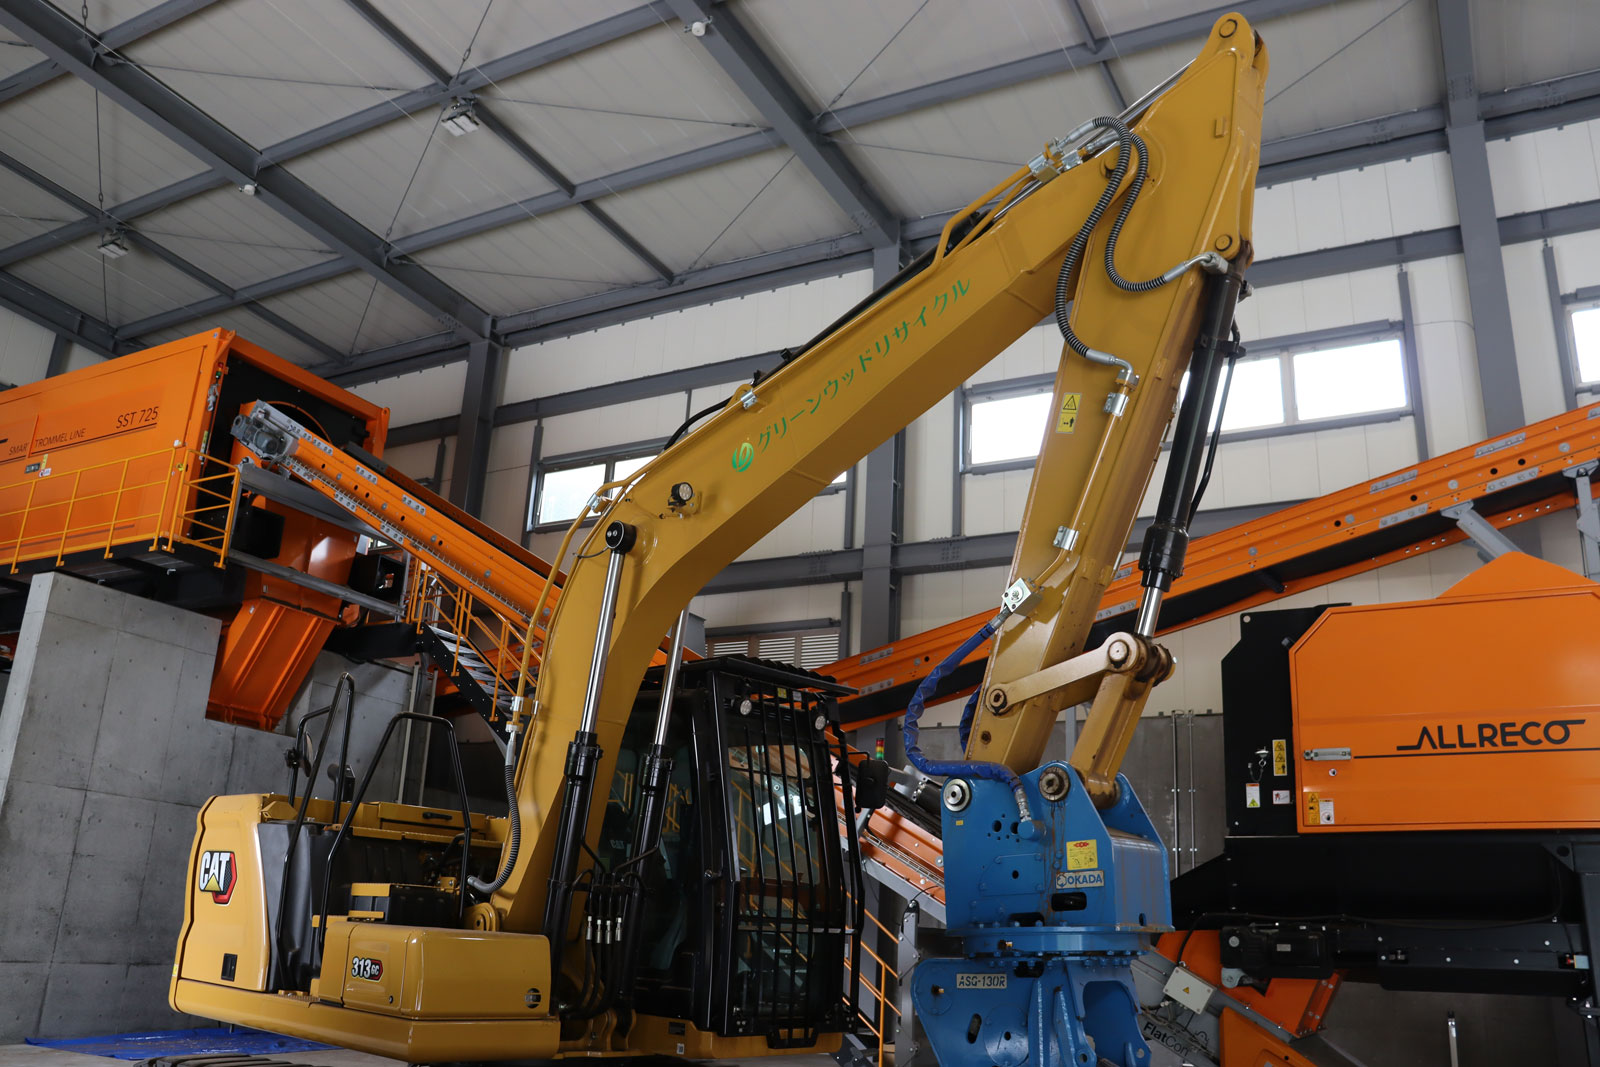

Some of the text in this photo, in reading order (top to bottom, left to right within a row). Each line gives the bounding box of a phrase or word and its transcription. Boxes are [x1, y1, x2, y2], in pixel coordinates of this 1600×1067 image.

[758, 278, 970, 453] グリーンウッドリサイクル
[115, 406, 160, 429] SST 725
[35, 432, 68, 448] TROMMEL
[69, 428, 86, 441] LINE
[1396, 719, 1586, 750] ALLRECO
[199, 851, 231, 891] CAT
[1067, 874, 1103, 885] OKADA
[352, 957, 371, 978] 313
[958, 975, 1006, 987] ASG-130R
[1143, 1021, 1191, 1057] FlatCon
